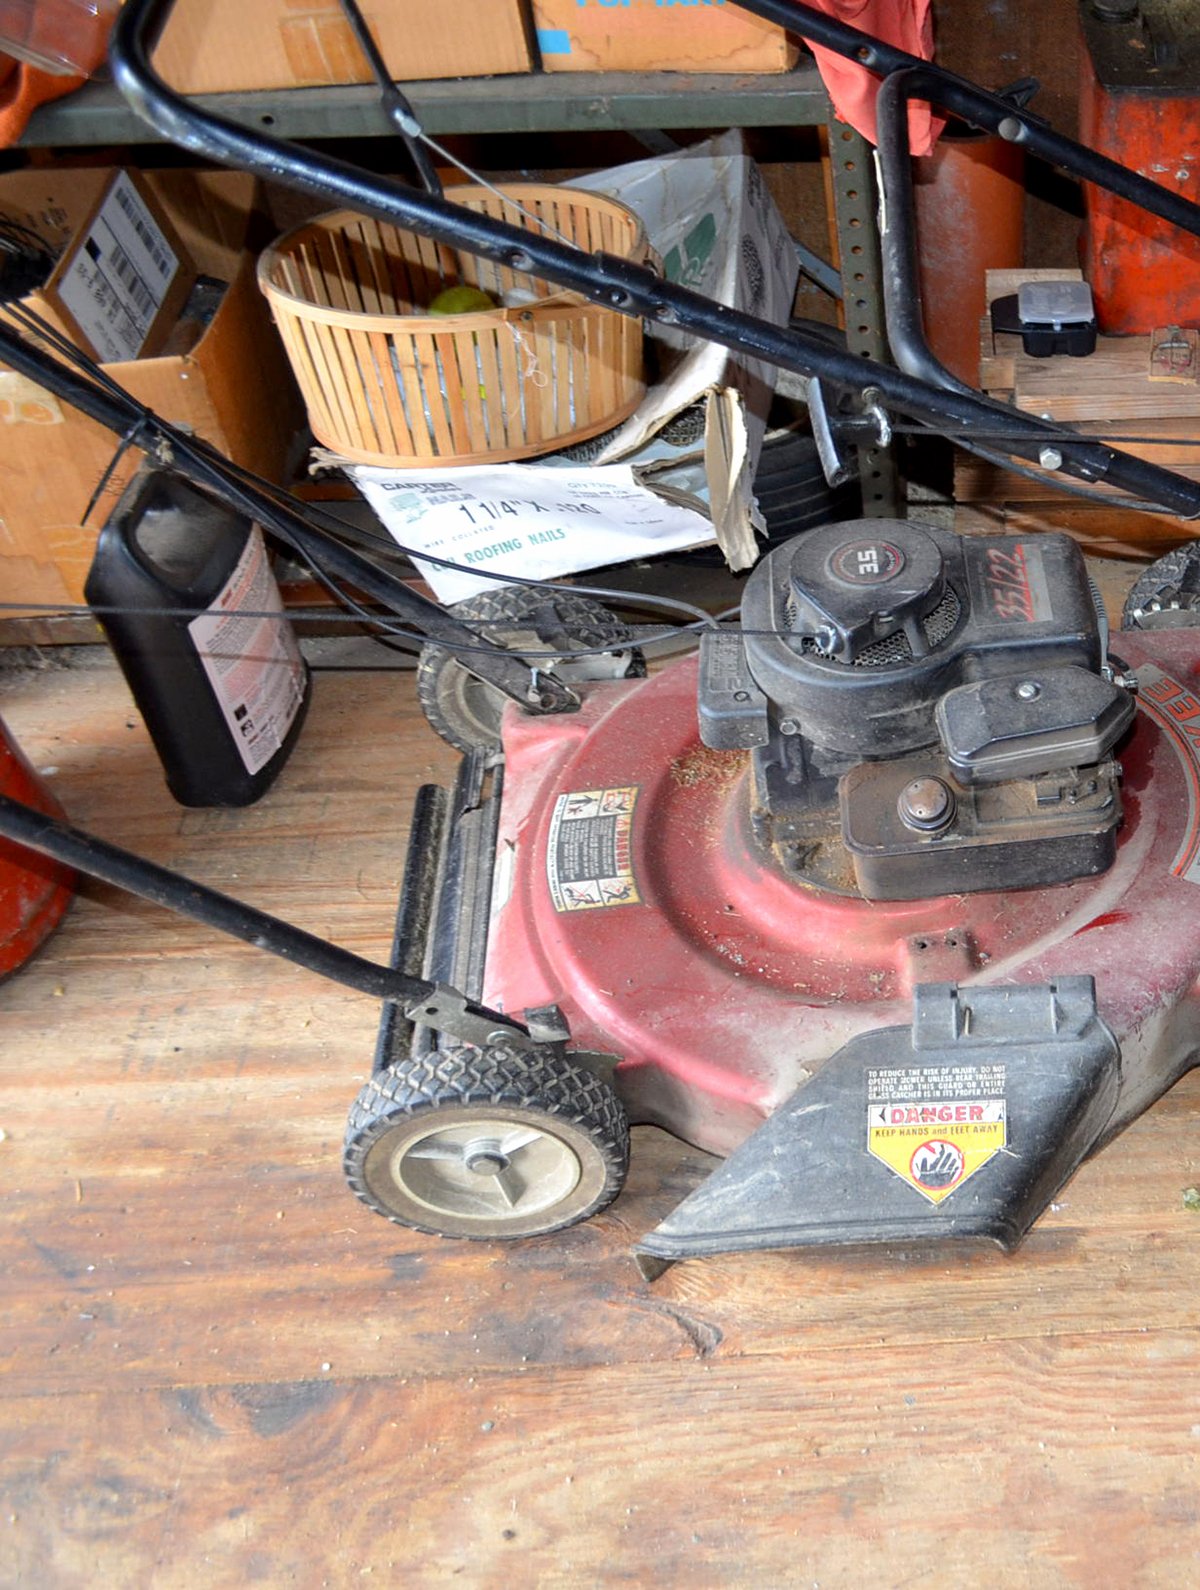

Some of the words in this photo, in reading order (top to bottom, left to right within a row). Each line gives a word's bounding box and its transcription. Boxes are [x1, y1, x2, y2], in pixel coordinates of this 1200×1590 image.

[464, 537, 523, 564] ROOFING
[528, 528, 567, 546] NAILS
[879, 1069, 906, 1078] REDUCE
[923, 1068, 938, 1076] RISK
[993, 1065, 1005, 1073] NOT
[868, 1077, 897, 1086] OPERATE
[899, 1083, 914, 1091] AND
[938, 1081, 963, 1090] GUARD
[980, 1079, 1005, 1088] ENTIRE
[955, 1088, 981, 1097] PROPER
[891, 1105, 984, 1124] DANGER
[875, 1128, 896, 1137] KEEP
[900, 1127, 930, 1136] HANDS
[932, 1127, 948, 1135] and
[973, 1124, 998, 1133] AWAY
